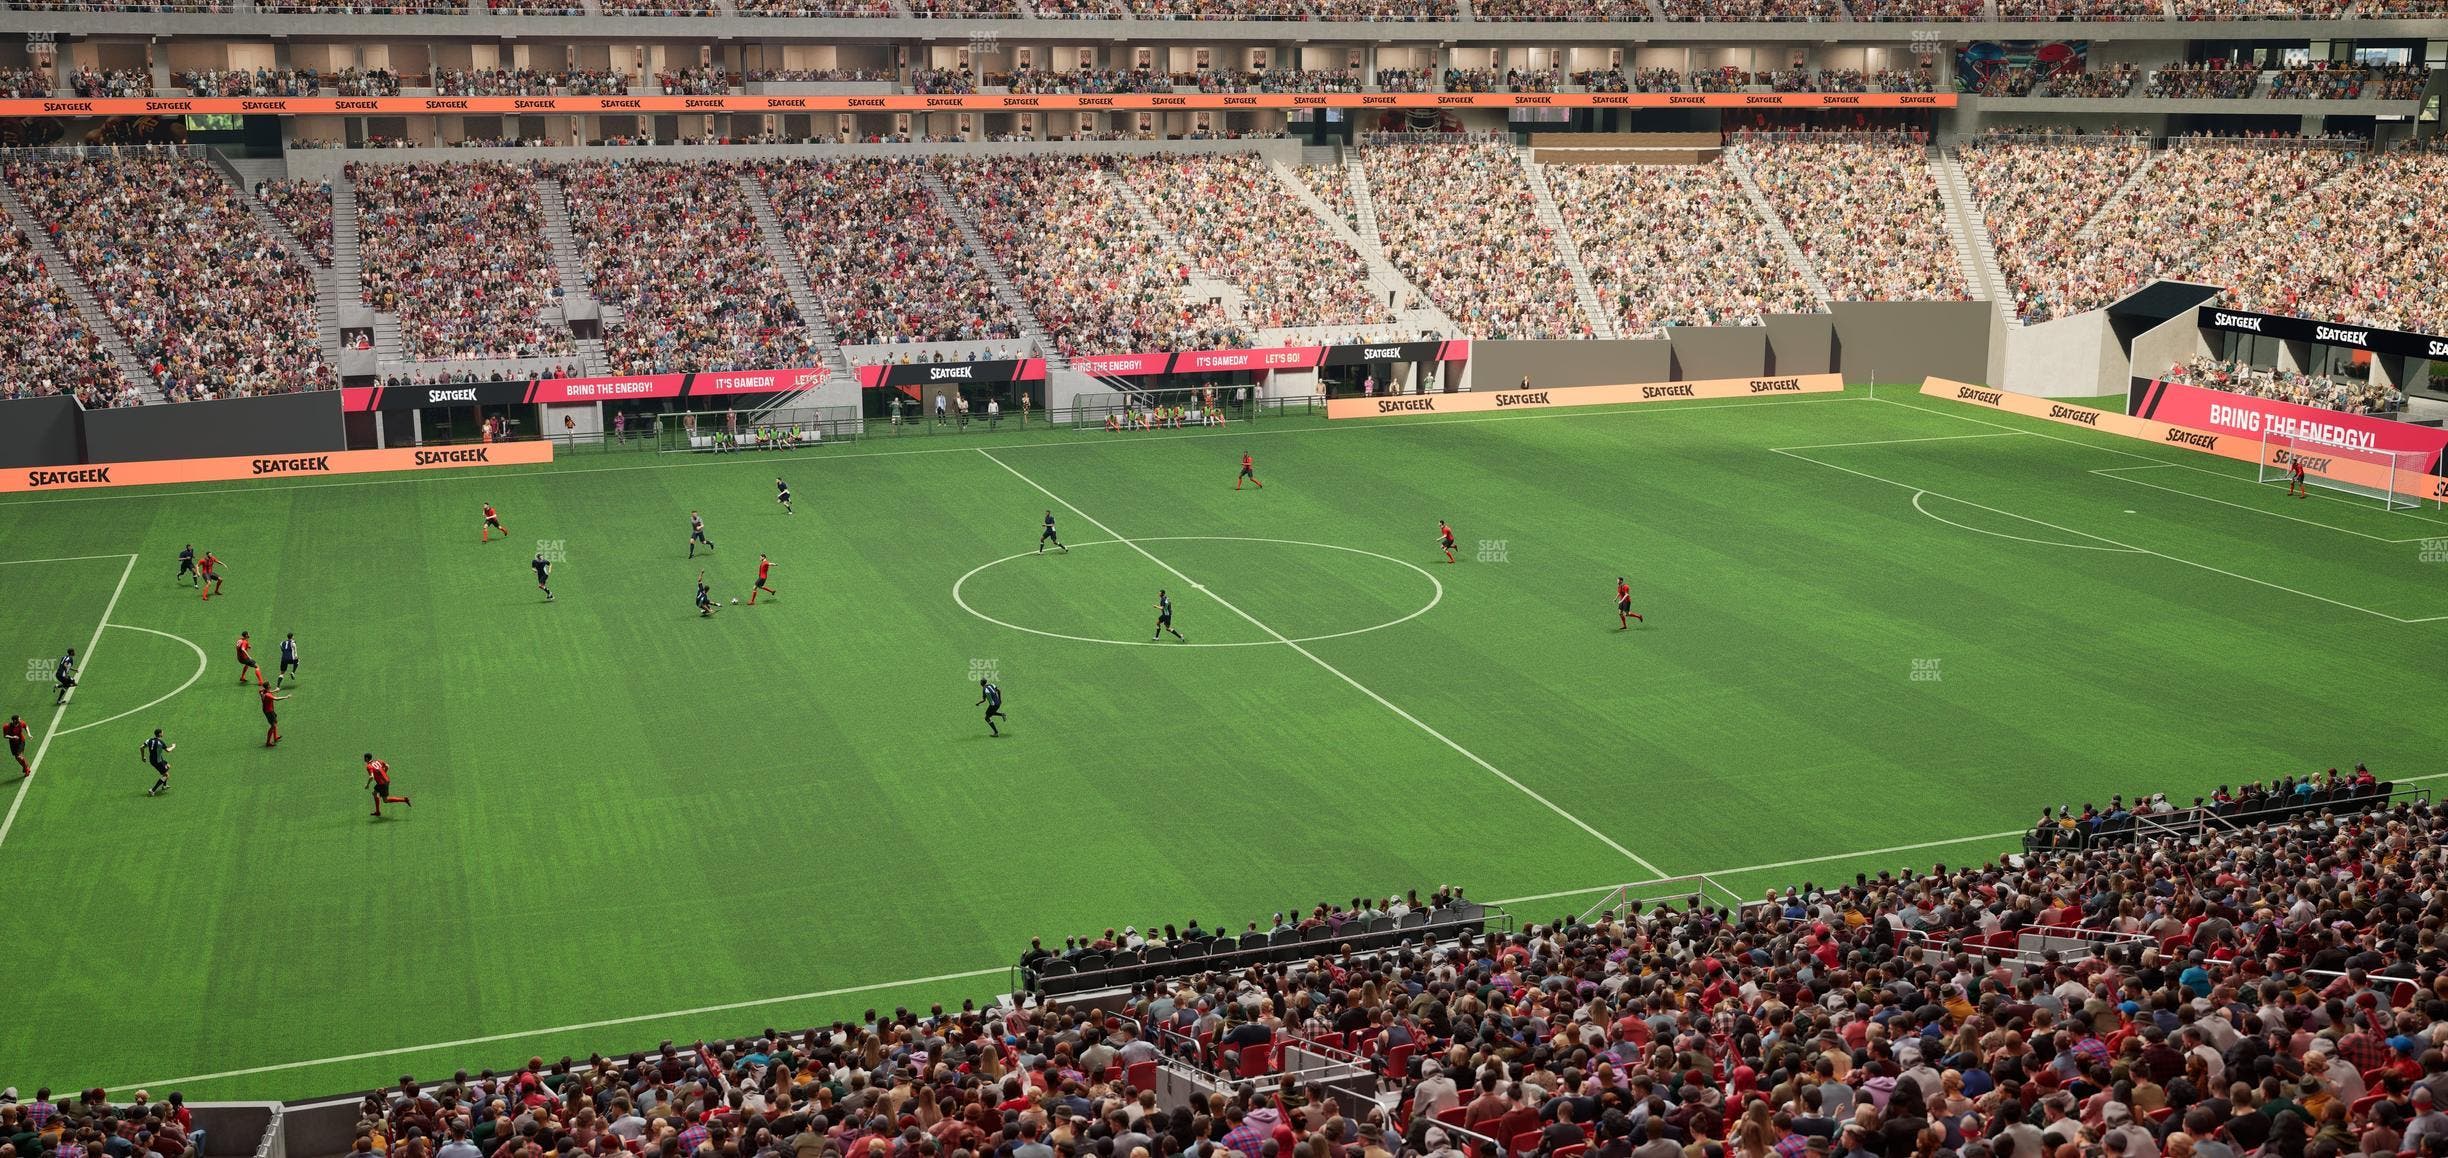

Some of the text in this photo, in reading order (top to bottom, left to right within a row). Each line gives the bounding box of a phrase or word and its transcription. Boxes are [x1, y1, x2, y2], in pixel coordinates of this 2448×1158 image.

[426, 100, 468, 110] SEATGEEK
[515, 100, 555, 109] SEATGEEK
[601, 100, 640, 109] SEATGEEK
[686, 99, 724, 108] SEATGEEK
[768, 99, 805, 108] SEATGEEK
[848, 99, 885, 107] SEATGEEK
[927, 98, 963, 107] SEATGEEK
[1004, 98, 1039, 107] SEATGEEK
[1079, 98, 1113, 106] SEATGEEK
[1152, 97, 1185, 106] SEATGEEK
[1224, 97, 1257, 105] SEATGEEK
[1294, 97, 1326, 105] SEATGEEK
[1363, 97, 1396, 105] SEATGEEK
[1438, 97, 1473, 105] SEATGEEK
[1515, 97, 1551, 105] SEATGEEK
[1593, 97, 1628, 105] SEATGEEK
[1670, 96, 1705, 105] SEATGEEK
[1746, 96, 1782, 104] SEATGEEK
[1824, 96, 1859, 104] SEATGEEK
[1900, 96, 1936, 104] SEATGEEK
[44, 102, 93, 112] SEATGEEK
[146, 102, 192, 112] SEATGEEK
[242, 101, 286, 111] SEATGEEK
[335, 101, 378, 110] SEATGEEK
[2215, 312, 2262, 332] SEATGEEK
[2316, 326, 2368, 346] SEATGEEK
[1266, 353, 1300, 363] LET'S GO!
[1364, 347, 1400, 360] SEATGEEK
[1109, 360, 1142, 370] ENERGY!
[1196, 356, 1248, 367] IT'S GAMEDAY
[931, 366, 973, 380] SEATGEEK
[716, 377, 775, 389] IT'S GAMEDAY
[1750, 379, 1800, 392] SEATGEEK
[567, 382, 652, 396] BRING THE ENERGY!
[1642, 384, 1694, 398] SEATGEEK
[429, 388, 478, 403] SEATGEEK
[1495, 392, 1550, 406] SEATGEEK
[1958, 386, 2003, 406] SEATGEEK
[1379, 398, 1434, 413] SEATGEEK
[2050, 404, 2100, 426] SEATGEEK
[2210, 404, 2260, 432] BRING
[2300, 420, 2376, 454] ENERGY!
[2166, 428, 2218, 450] SEATGEEK
[415, 448, 488, 465] SEATGEEK
[252, 456, 329, 474] SEATGEEK
[29, 467, 111, 486] SEATGEEK
